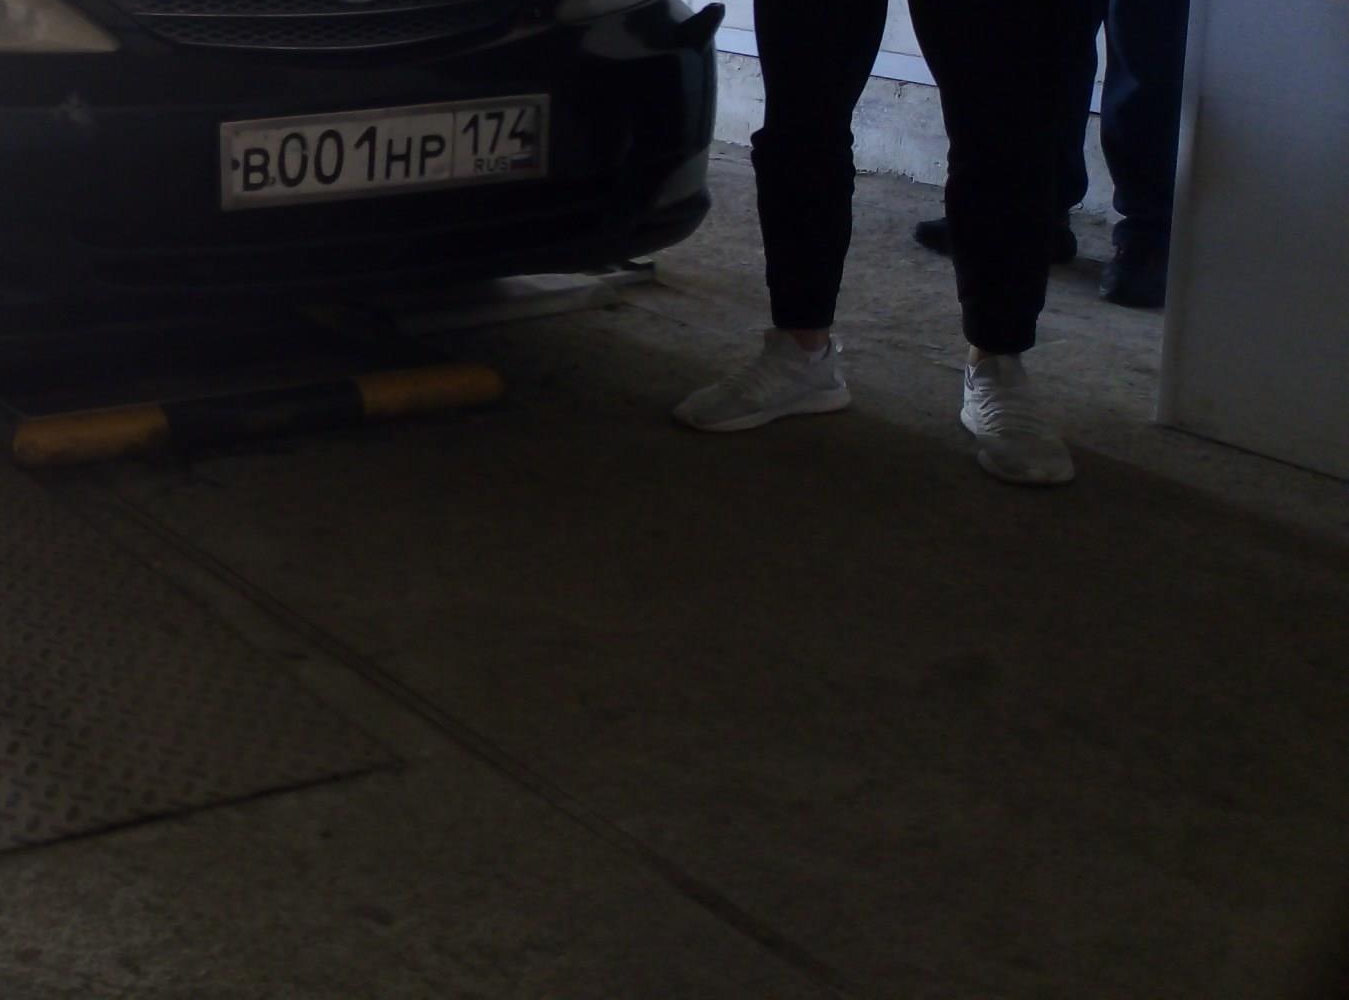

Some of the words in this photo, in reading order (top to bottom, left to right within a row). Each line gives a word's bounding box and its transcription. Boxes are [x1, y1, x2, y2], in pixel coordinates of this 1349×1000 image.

[242, 126, 446, 192] В001НР
[462, 108, 536, 155] 174
[474, 156, 509, 173] RUS
